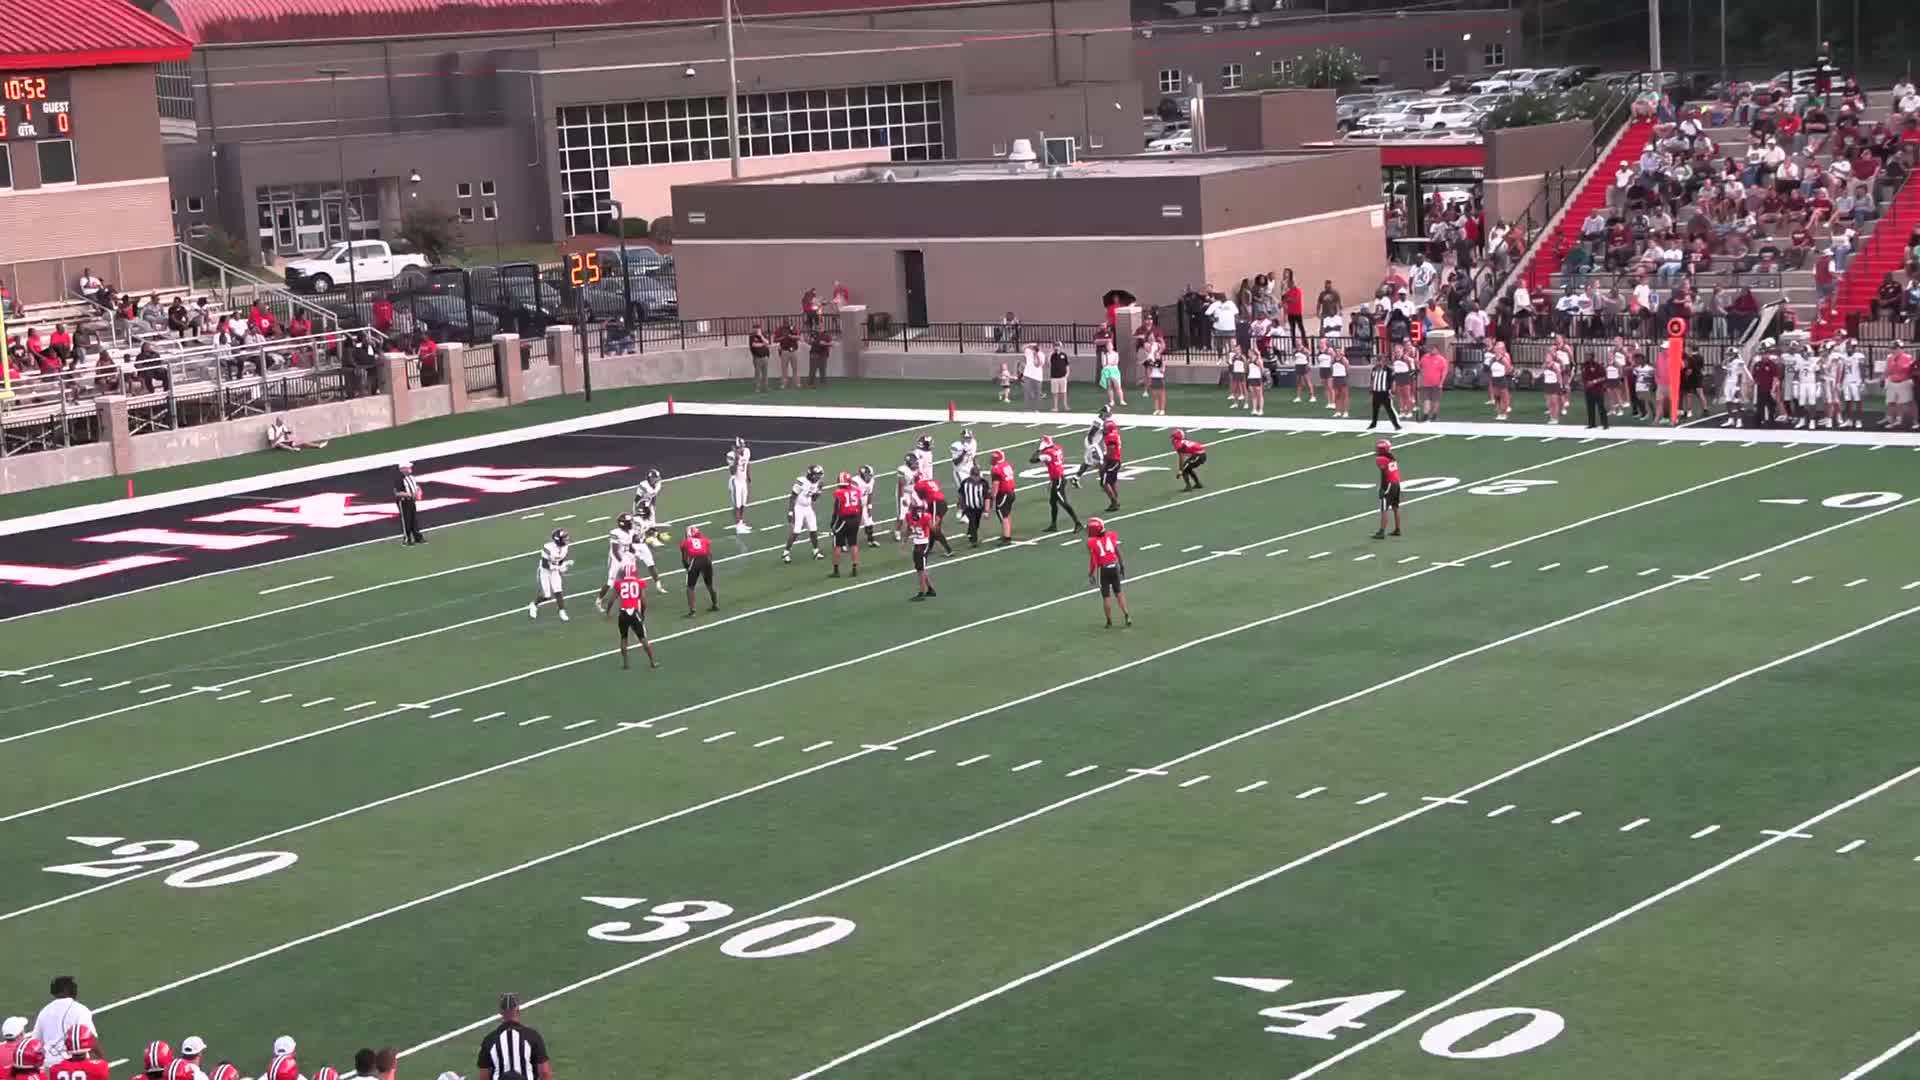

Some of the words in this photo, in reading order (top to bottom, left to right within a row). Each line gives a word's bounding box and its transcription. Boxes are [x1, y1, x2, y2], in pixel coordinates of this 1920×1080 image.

[4, 78, 47, 100] 10:52
[25, 103, 32, 121] 1
[42, 101, 69, 113] GUEST
[58, 113, 69, 133] 0
[570, 251, 601, 287] 25
[843, 491, 860, 508] 15
[691, 538, 702, 550] 8
[1096, 539, 1116, 557] 14
[619, 582, 640, 599] 20
[42, 839, 299, 888] 20
[587, 900, 857, 958] 30
[1257, 989, 1565, 1060] 40
